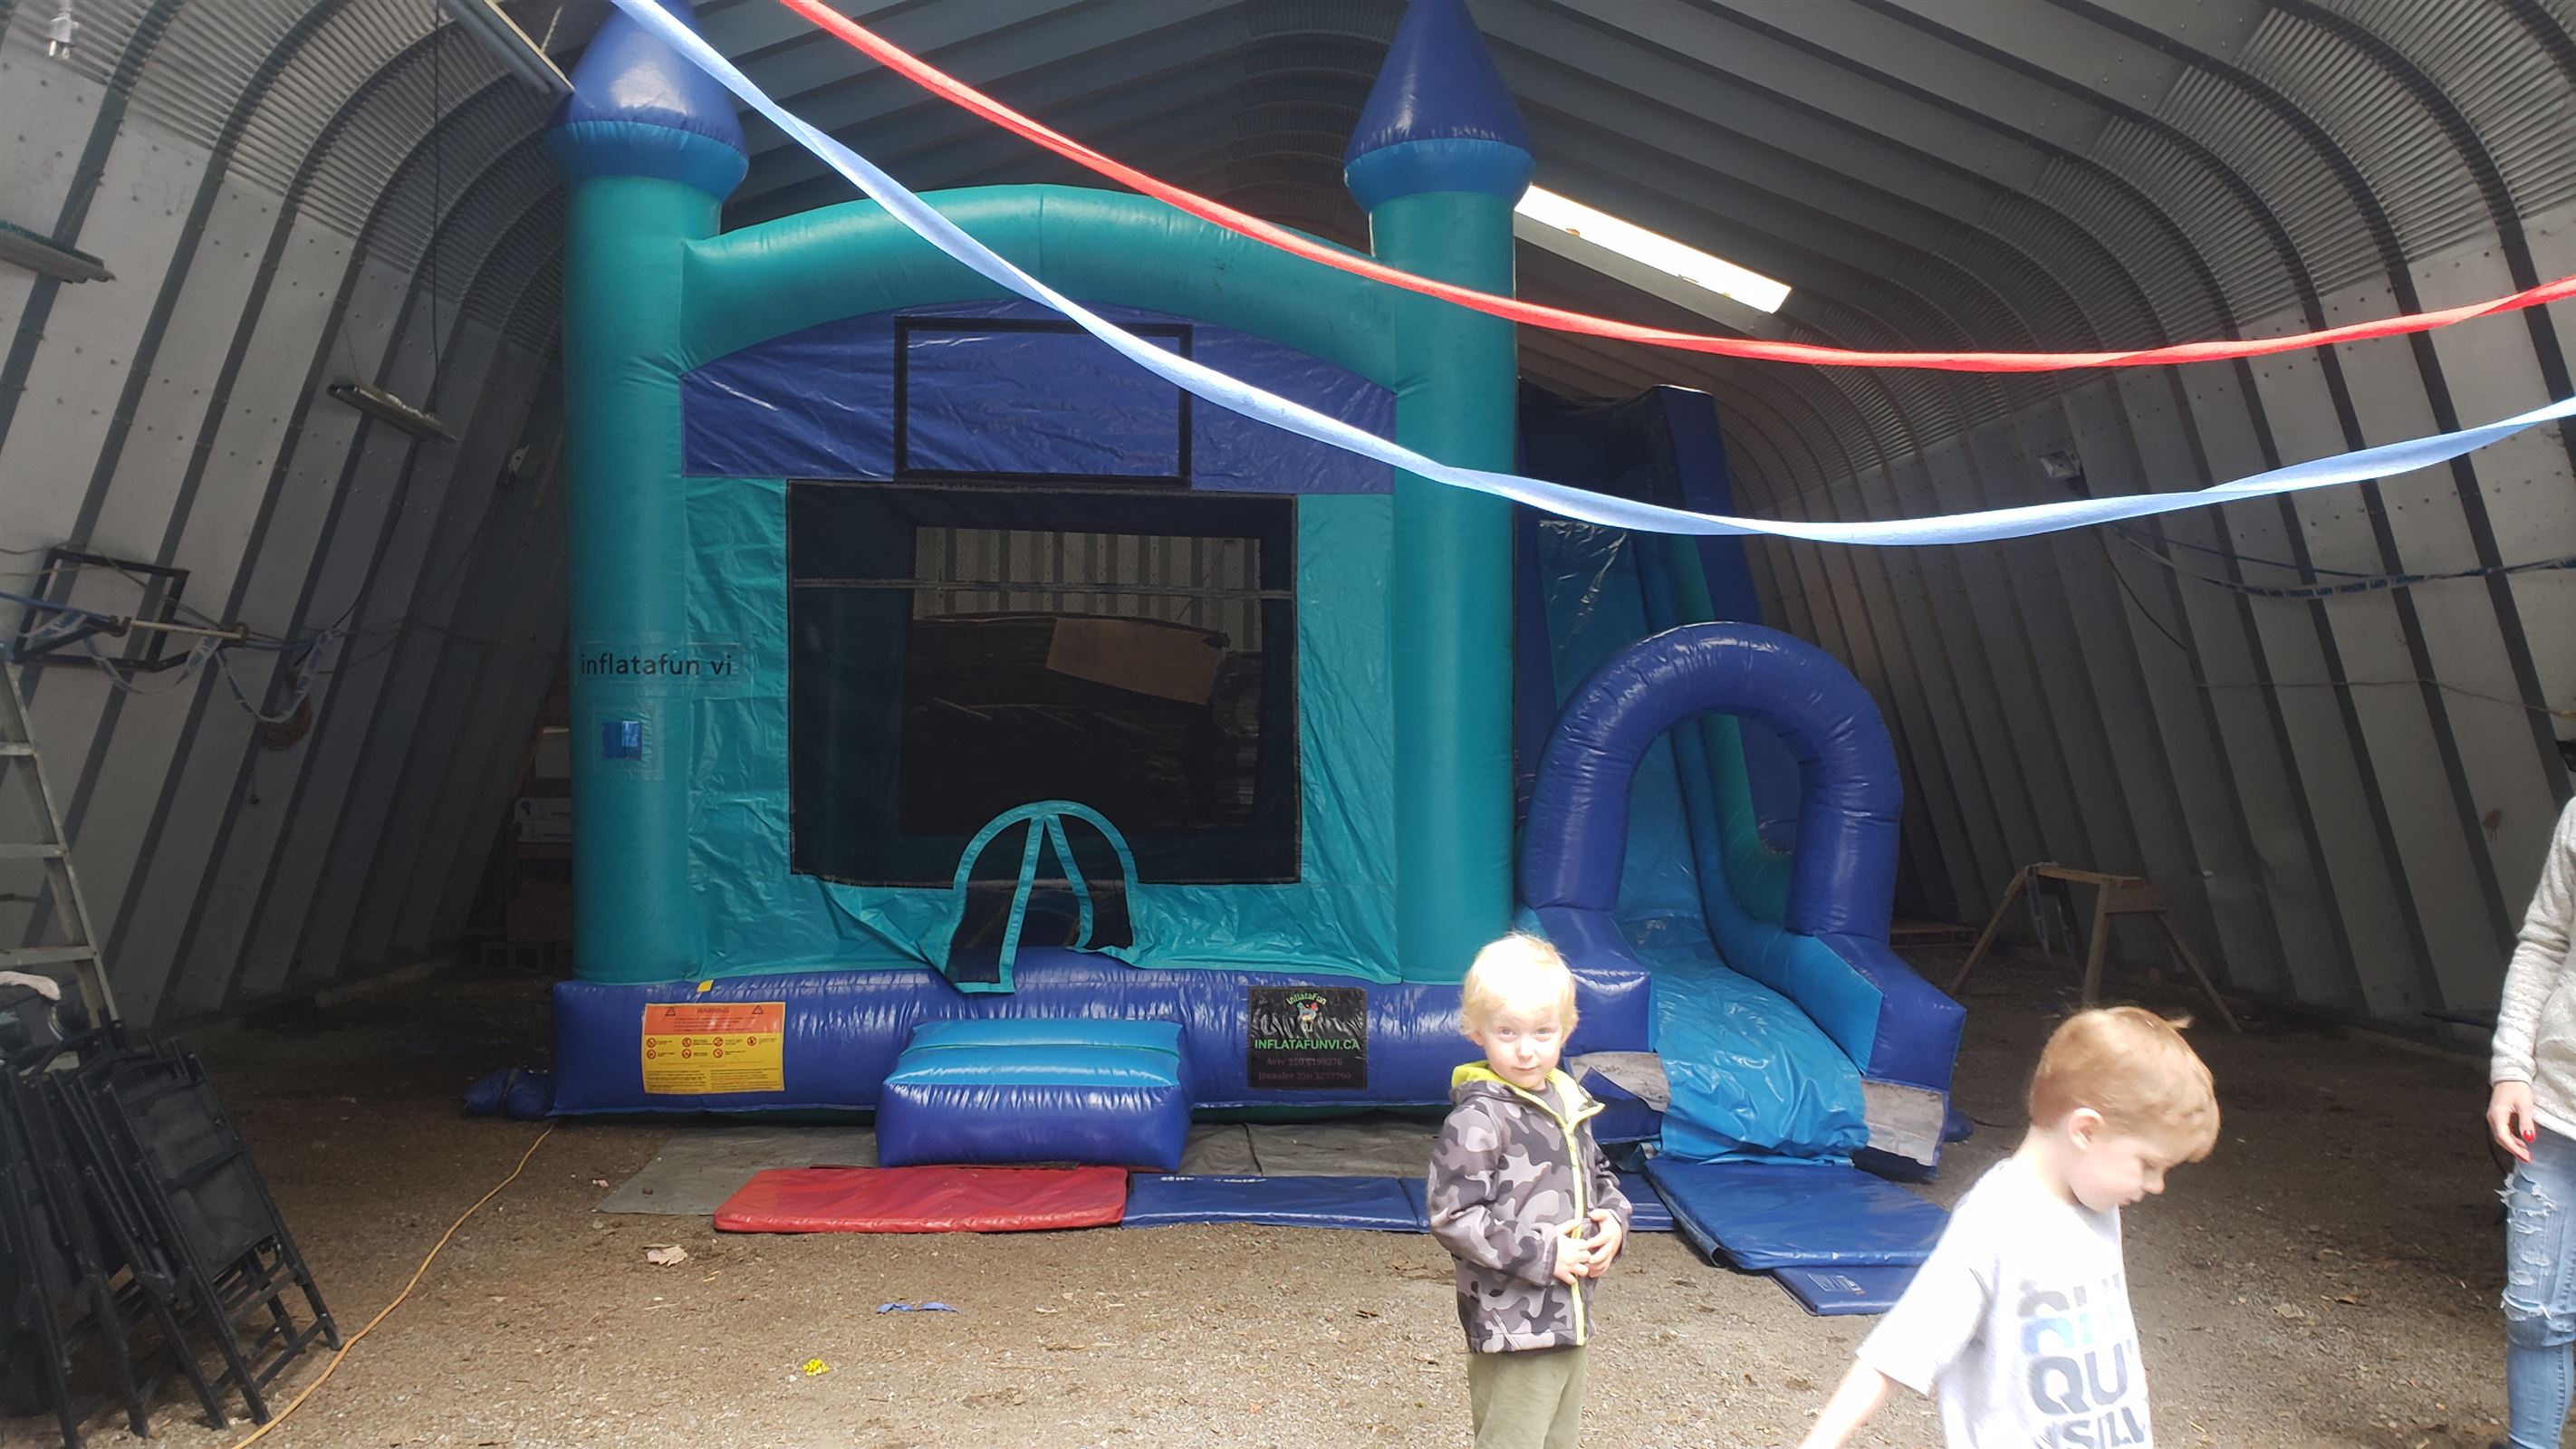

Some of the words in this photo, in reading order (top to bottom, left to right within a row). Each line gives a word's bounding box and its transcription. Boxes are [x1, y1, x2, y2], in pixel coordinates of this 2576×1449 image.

[581, 653, 700, 676] inflatafun
[710, 655, 732, 676] vi
[1254, 1039, 1360, 1050] INFLATAFUNVI.CA
[2026, 1339, 2134, 1415] QU
